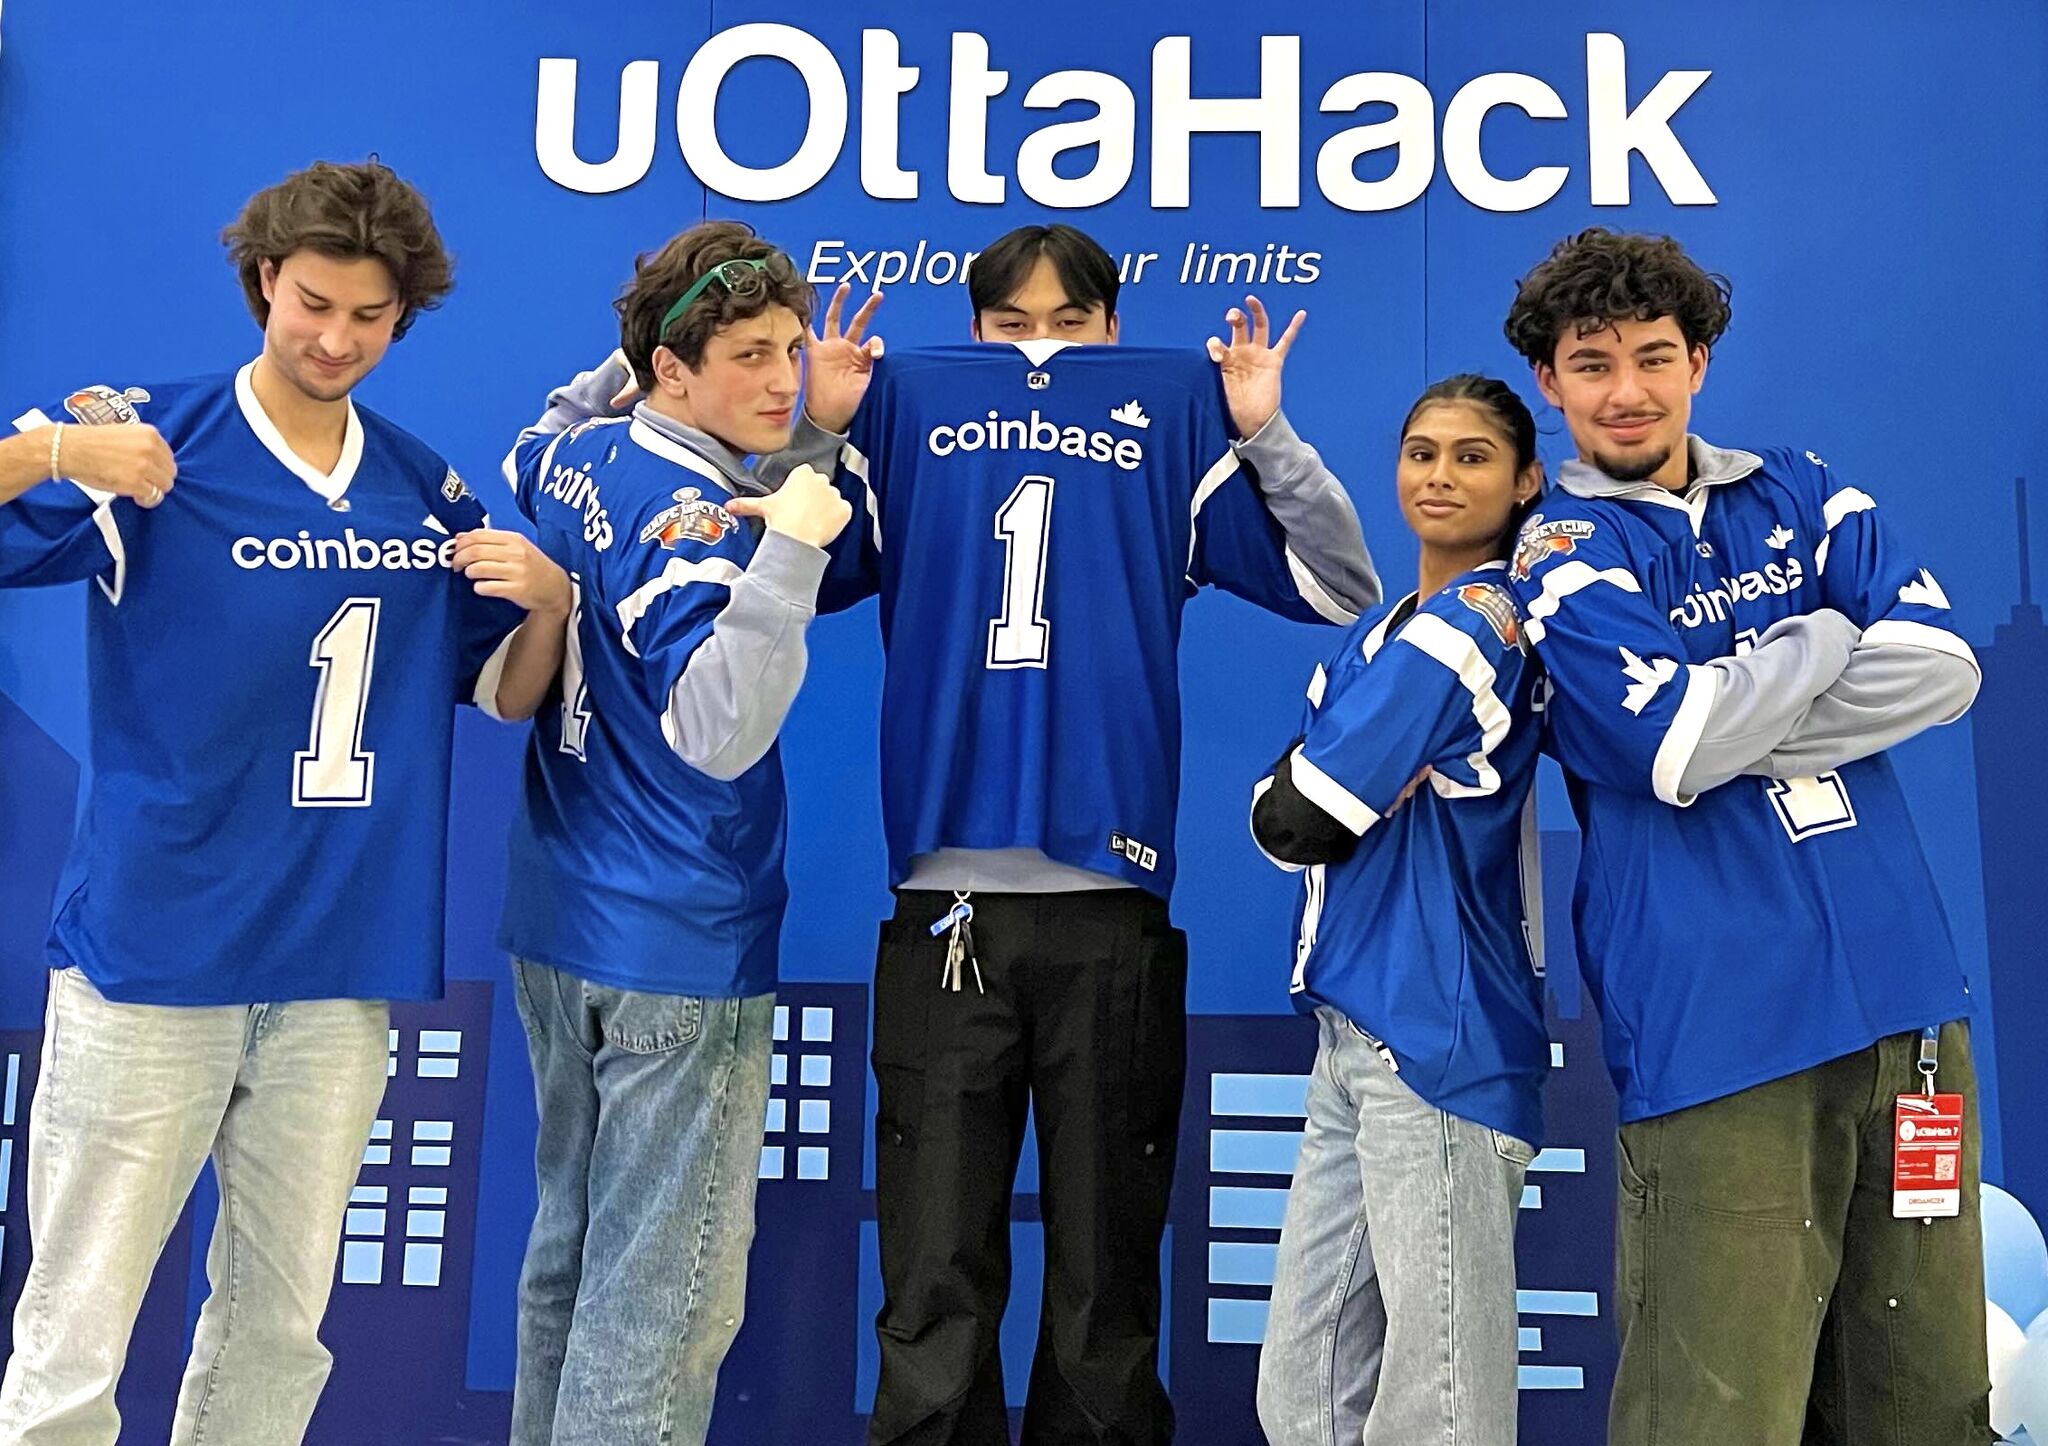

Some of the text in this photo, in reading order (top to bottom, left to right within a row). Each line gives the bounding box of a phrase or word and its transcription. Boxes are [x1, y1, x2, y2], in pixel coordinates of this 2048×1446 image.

[535, 22, 1718, 212] uOttaHack
[806, 240, 981, 293] Explor
[1179, 243, 1322, 284] limits
[928, 410, 1144, 471] coinbase
[231, 528, 457, 570] coinbase
[1561, 521, 1593, 535] CUP
[986, 475, 1056, 670] 1
[291, 597, 382, 808] 1
